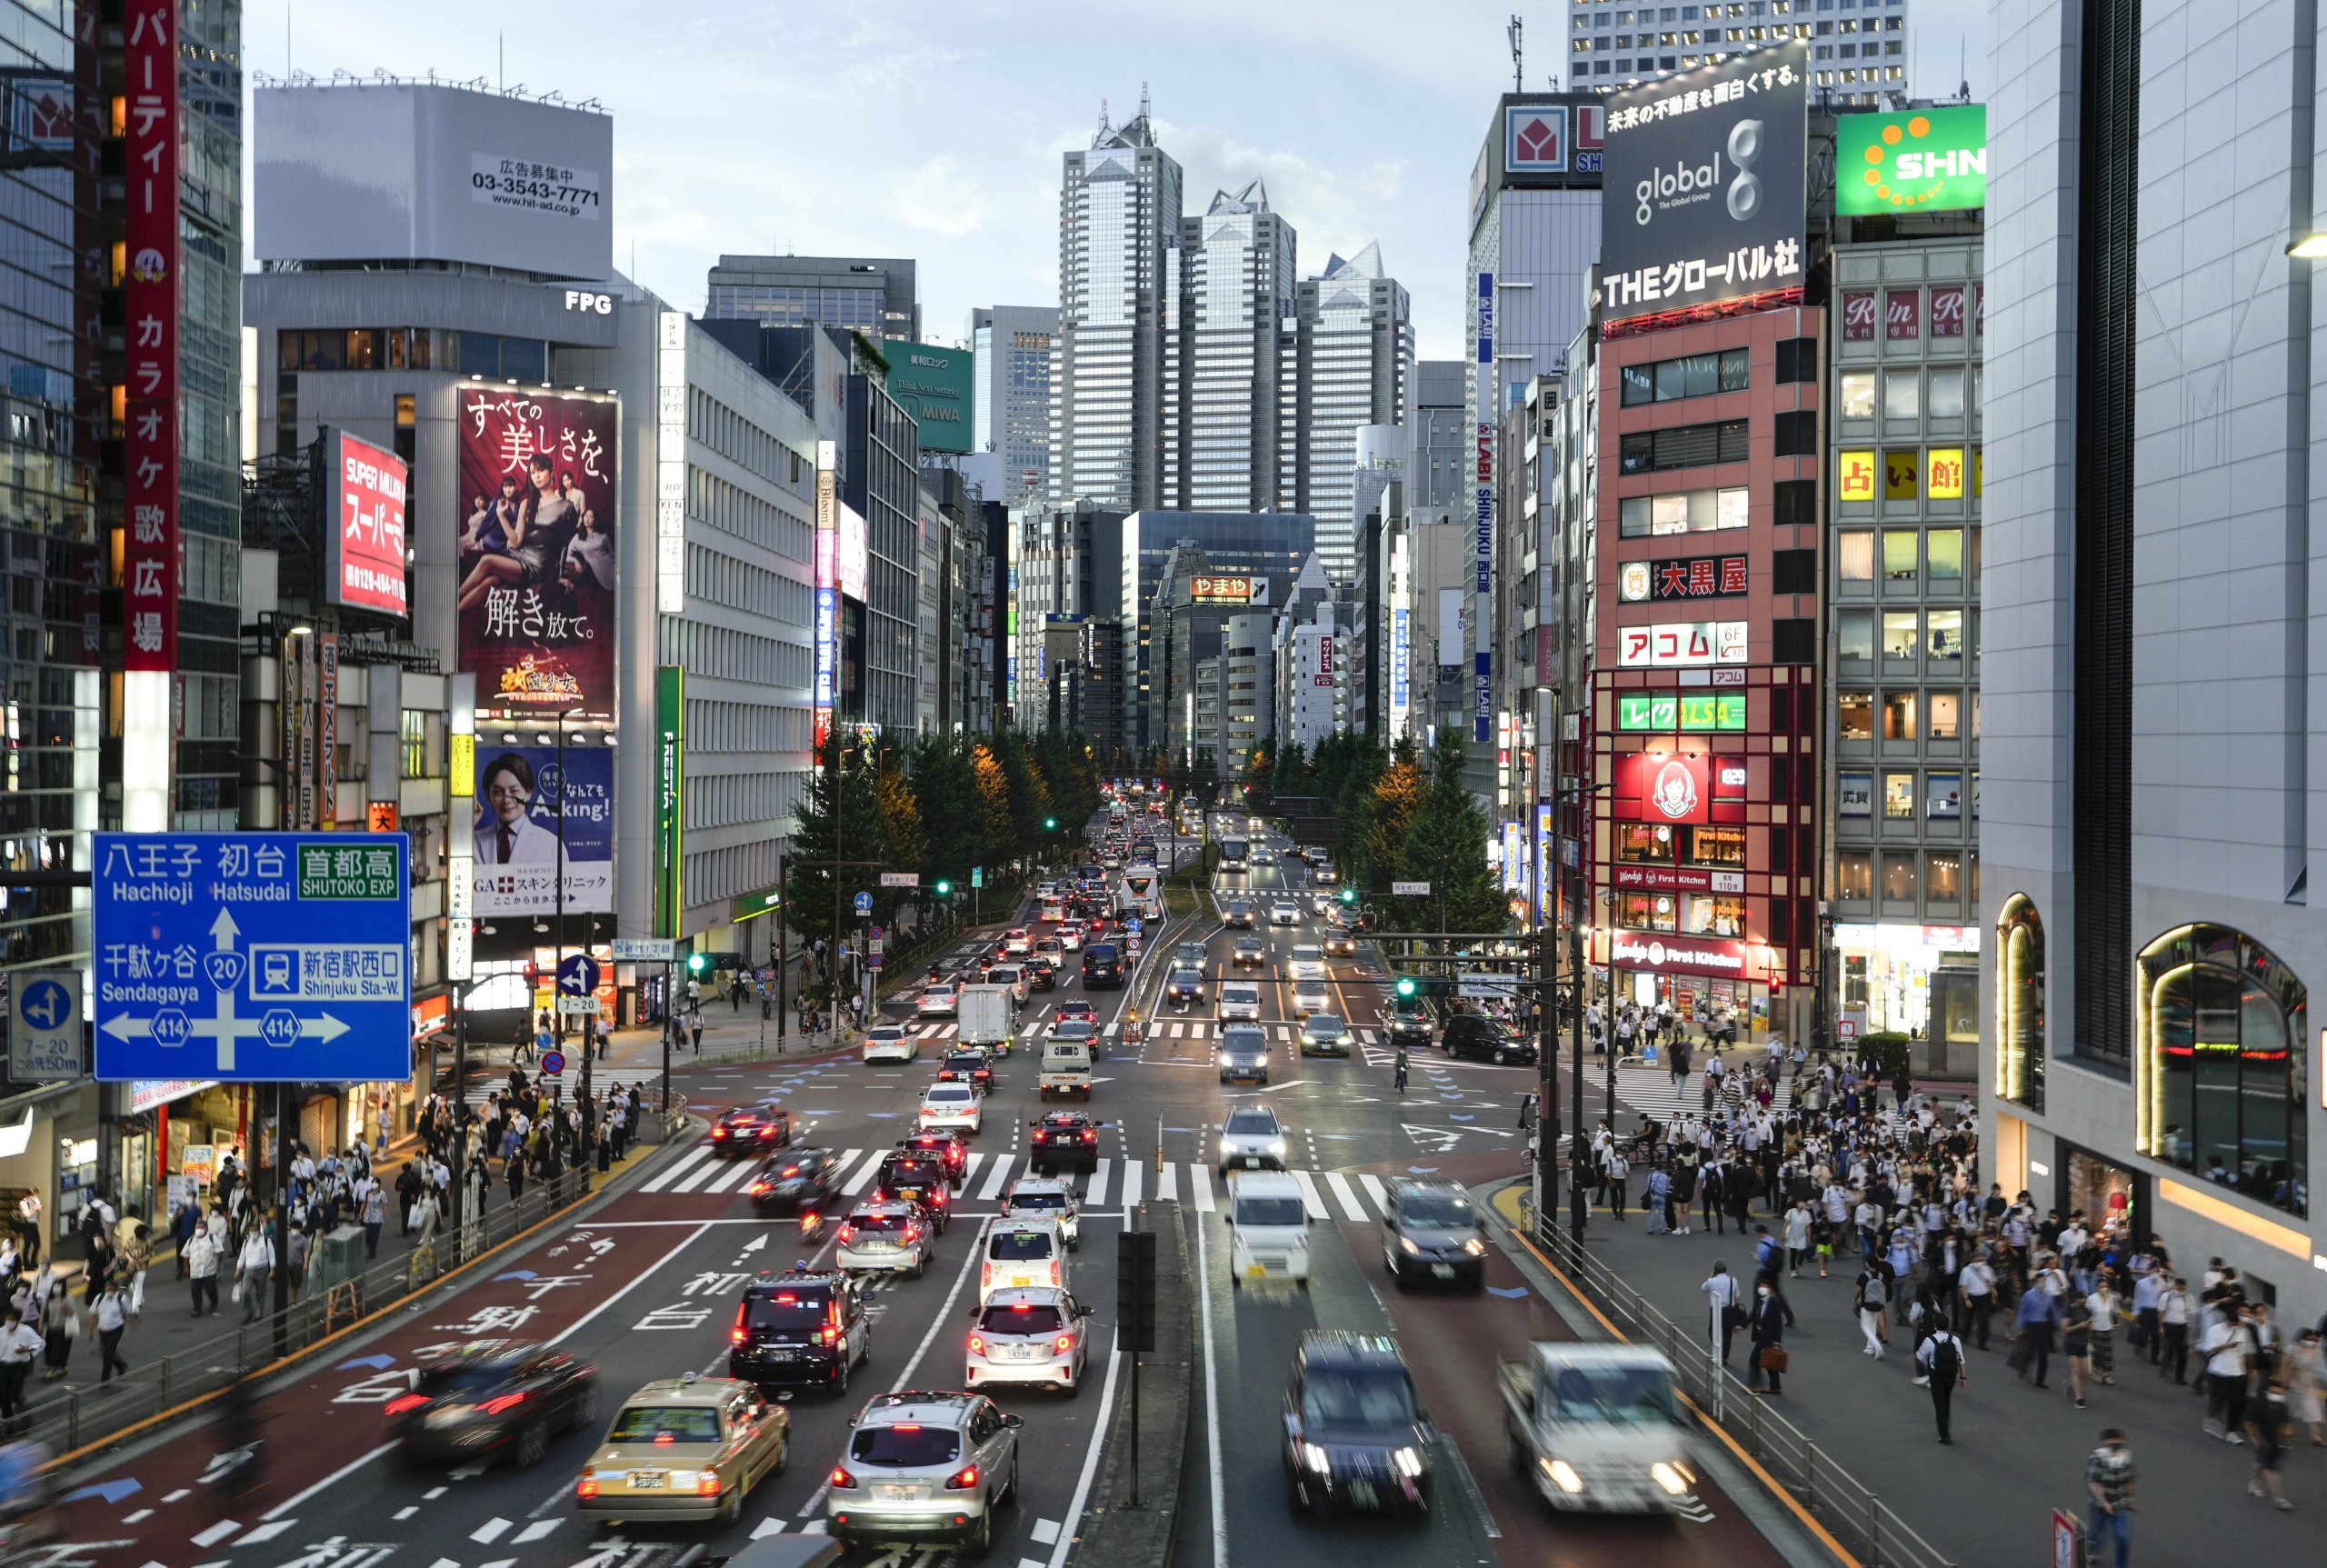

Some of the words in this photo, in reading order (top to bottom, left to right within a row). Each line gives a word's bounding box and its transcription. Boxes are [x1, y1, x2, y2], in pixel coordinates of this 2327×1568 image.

[1608, 64, 1800, 134] 未来の不動産を面白くする。
[131, 10, 167, 215] パーティー
[501, 159, 574, 185] 広告募集中
[473, 172, 599, 206] 03-3543-7771
[1636, 151, 1720, 225] global
[1659, 200, 1671, 210] The
[1671, 195, 1691, 208] Global
[1692, 192, 1711, 205] Group
[493, 194, 580, 217] www.hit-ad.co.jp
[1603, 237, 1800, 308] THEグローバル社
[565, 291, 612, 315] FPG
[1483, 310, 1493, 339] LABI
[1845, 325, 1917, 339] 女性専用
[911, 355, 948, 368] 美和ロック
[897, 380, 916, 391] Think
[919, 383, 934, 393] Next
[934, 385, 960, 397] Security
[467, 394, 543, 438] すべての
[922, 404, 960, 423] MIWA
[1477, 437, 1492, 483] LABI
[133, 313, 165, 653] カラオケ歌広場
[346, 456, 377, 492] SUPER
[821, 488, 831, 523] Bloom
[1477, 488, 1491, 555] SHINJUKU
[1195, 579, 1246, 594] やまや
[1628, 571, 1644, 594] 質
[1662, 557, 1747, 596] 大黒屋
[484, 585, 595, 640] 解き放て。
[1628, 631, 1709, 660] アコム
[1724, 627, 1742, 642] 6F
[1323, 640, 1331, 670] クリナップ
[1715, 672, 1743, 683] アコム
[1481, 689, 1490, 718] LABI
[566, 784, 604, 798] なんでも
[104, 844, 202, 879] 八王子
[218, 843, 285, 879] 初台
[304, 849, 394, 879] 首都高
[303, 879, 365, 895] SHUTOKO
[370, 879, 395, 895] EXP
[1620, 869, 1643, 884] Wendy's
[1659, 874, 1675, 883] First
[1679, 875, 1706, 884] Kitchen
[113, 883, 194, 905] Hachioji
[214, 883, 290, 902] Hatsudai
[214, 959, 236, 980] 20
[303, 950, 399, 978] 新宿駅西口
[1666, 949, 1694, 964] First
[1695, 951, 1742, 969] Kitchen
[102, 982, 198, 1006] Sendagaya
[305, 980, 356, 998] Shinjuku
[360, 981, 399, 996] Sta.-W.
[156, 1017, 185, 1038] 414
[266, 1017, 294, 1038] 414
